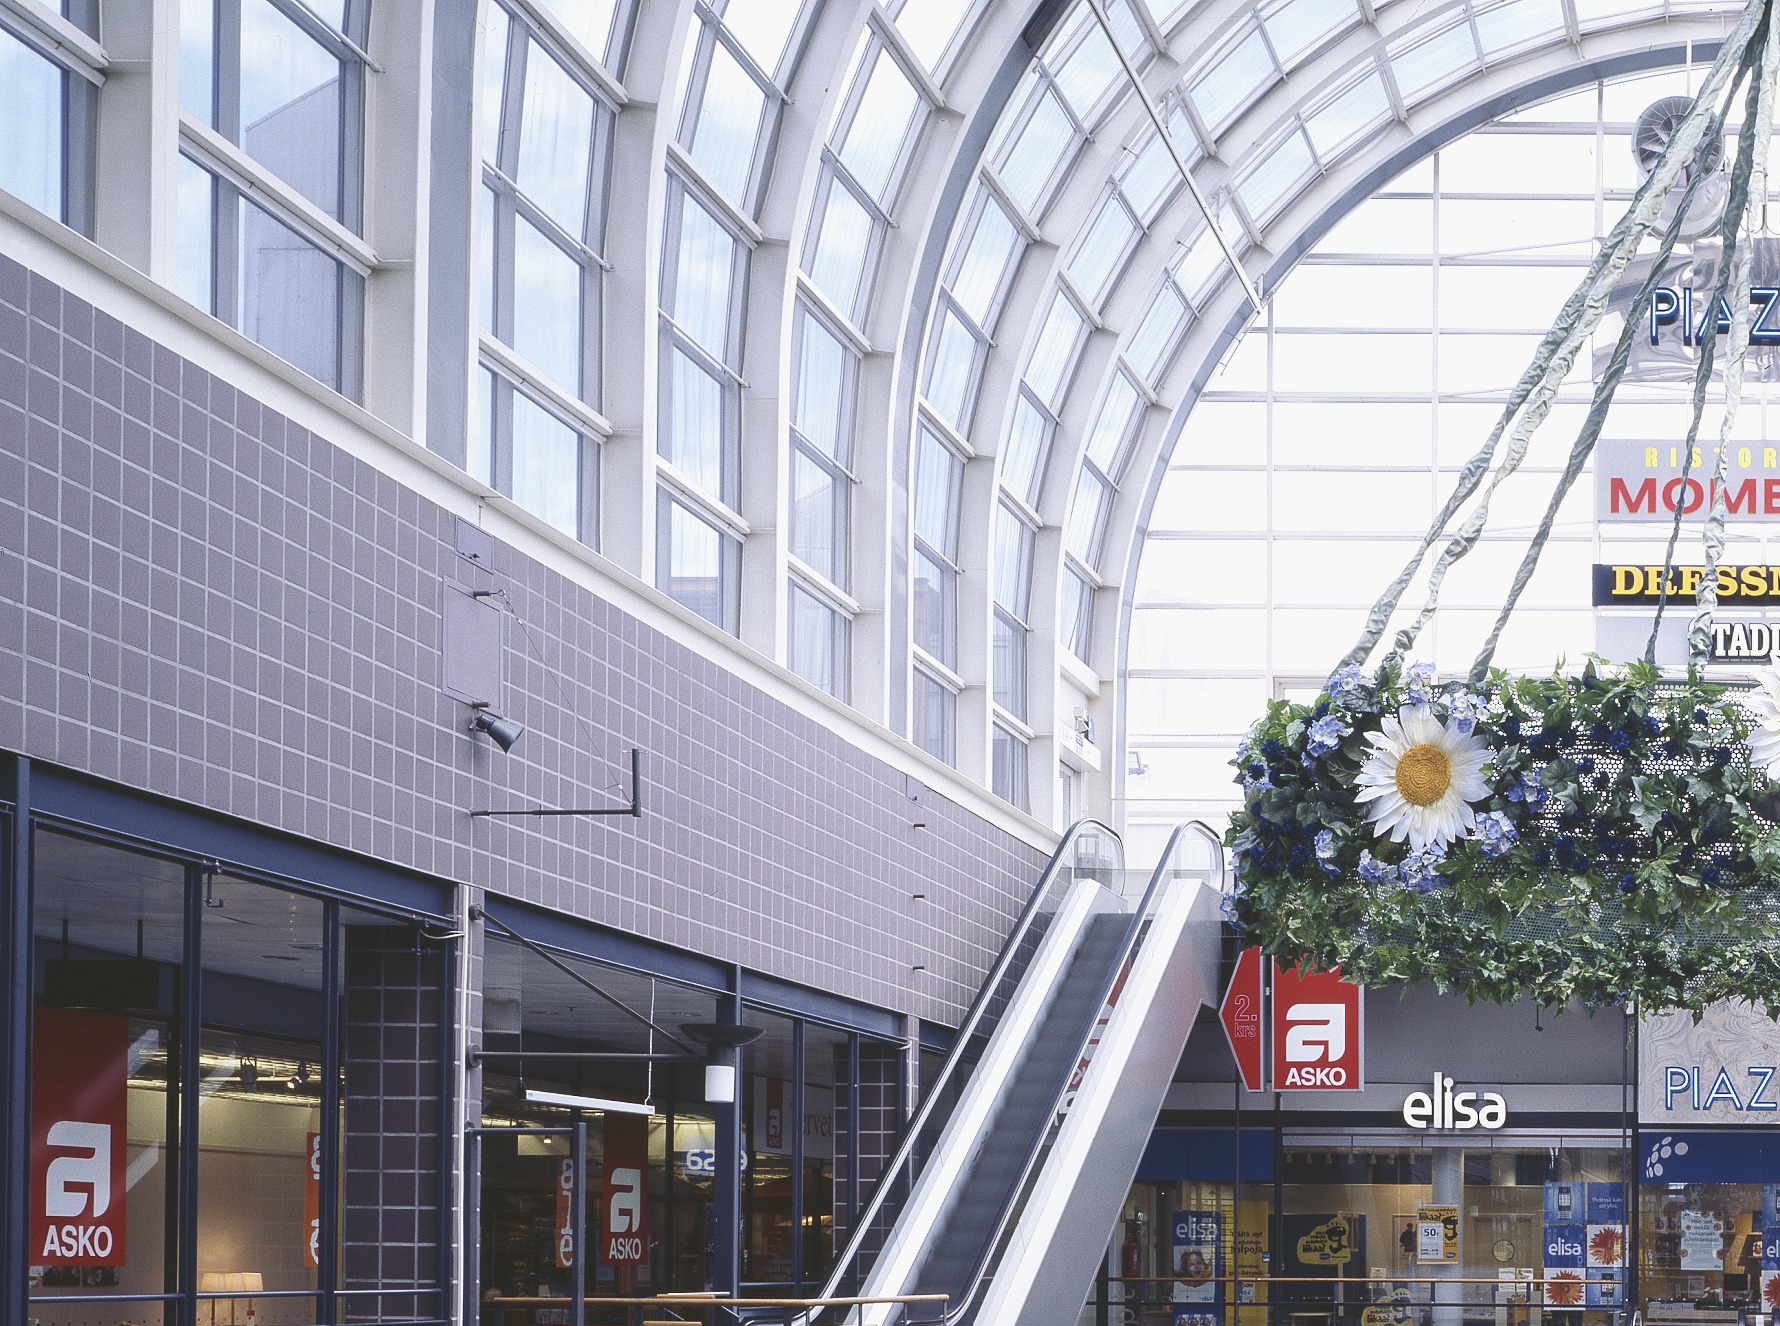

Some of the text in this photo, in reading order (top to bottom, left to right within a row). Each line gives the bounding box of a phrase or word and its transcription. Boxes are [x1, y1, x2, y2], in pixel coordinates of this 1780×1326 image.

[1285, 1067, 1346, 1087] ASKO
[1403, 1072, 1507, 1129] elisa
[1176, 1215, 1217, 1238] elisa
[42, 1224, 113, 1259] ASKO
[609, 1237, 642, 1260] ASKO
[1548, 1237, 1582, 1256] elisa
